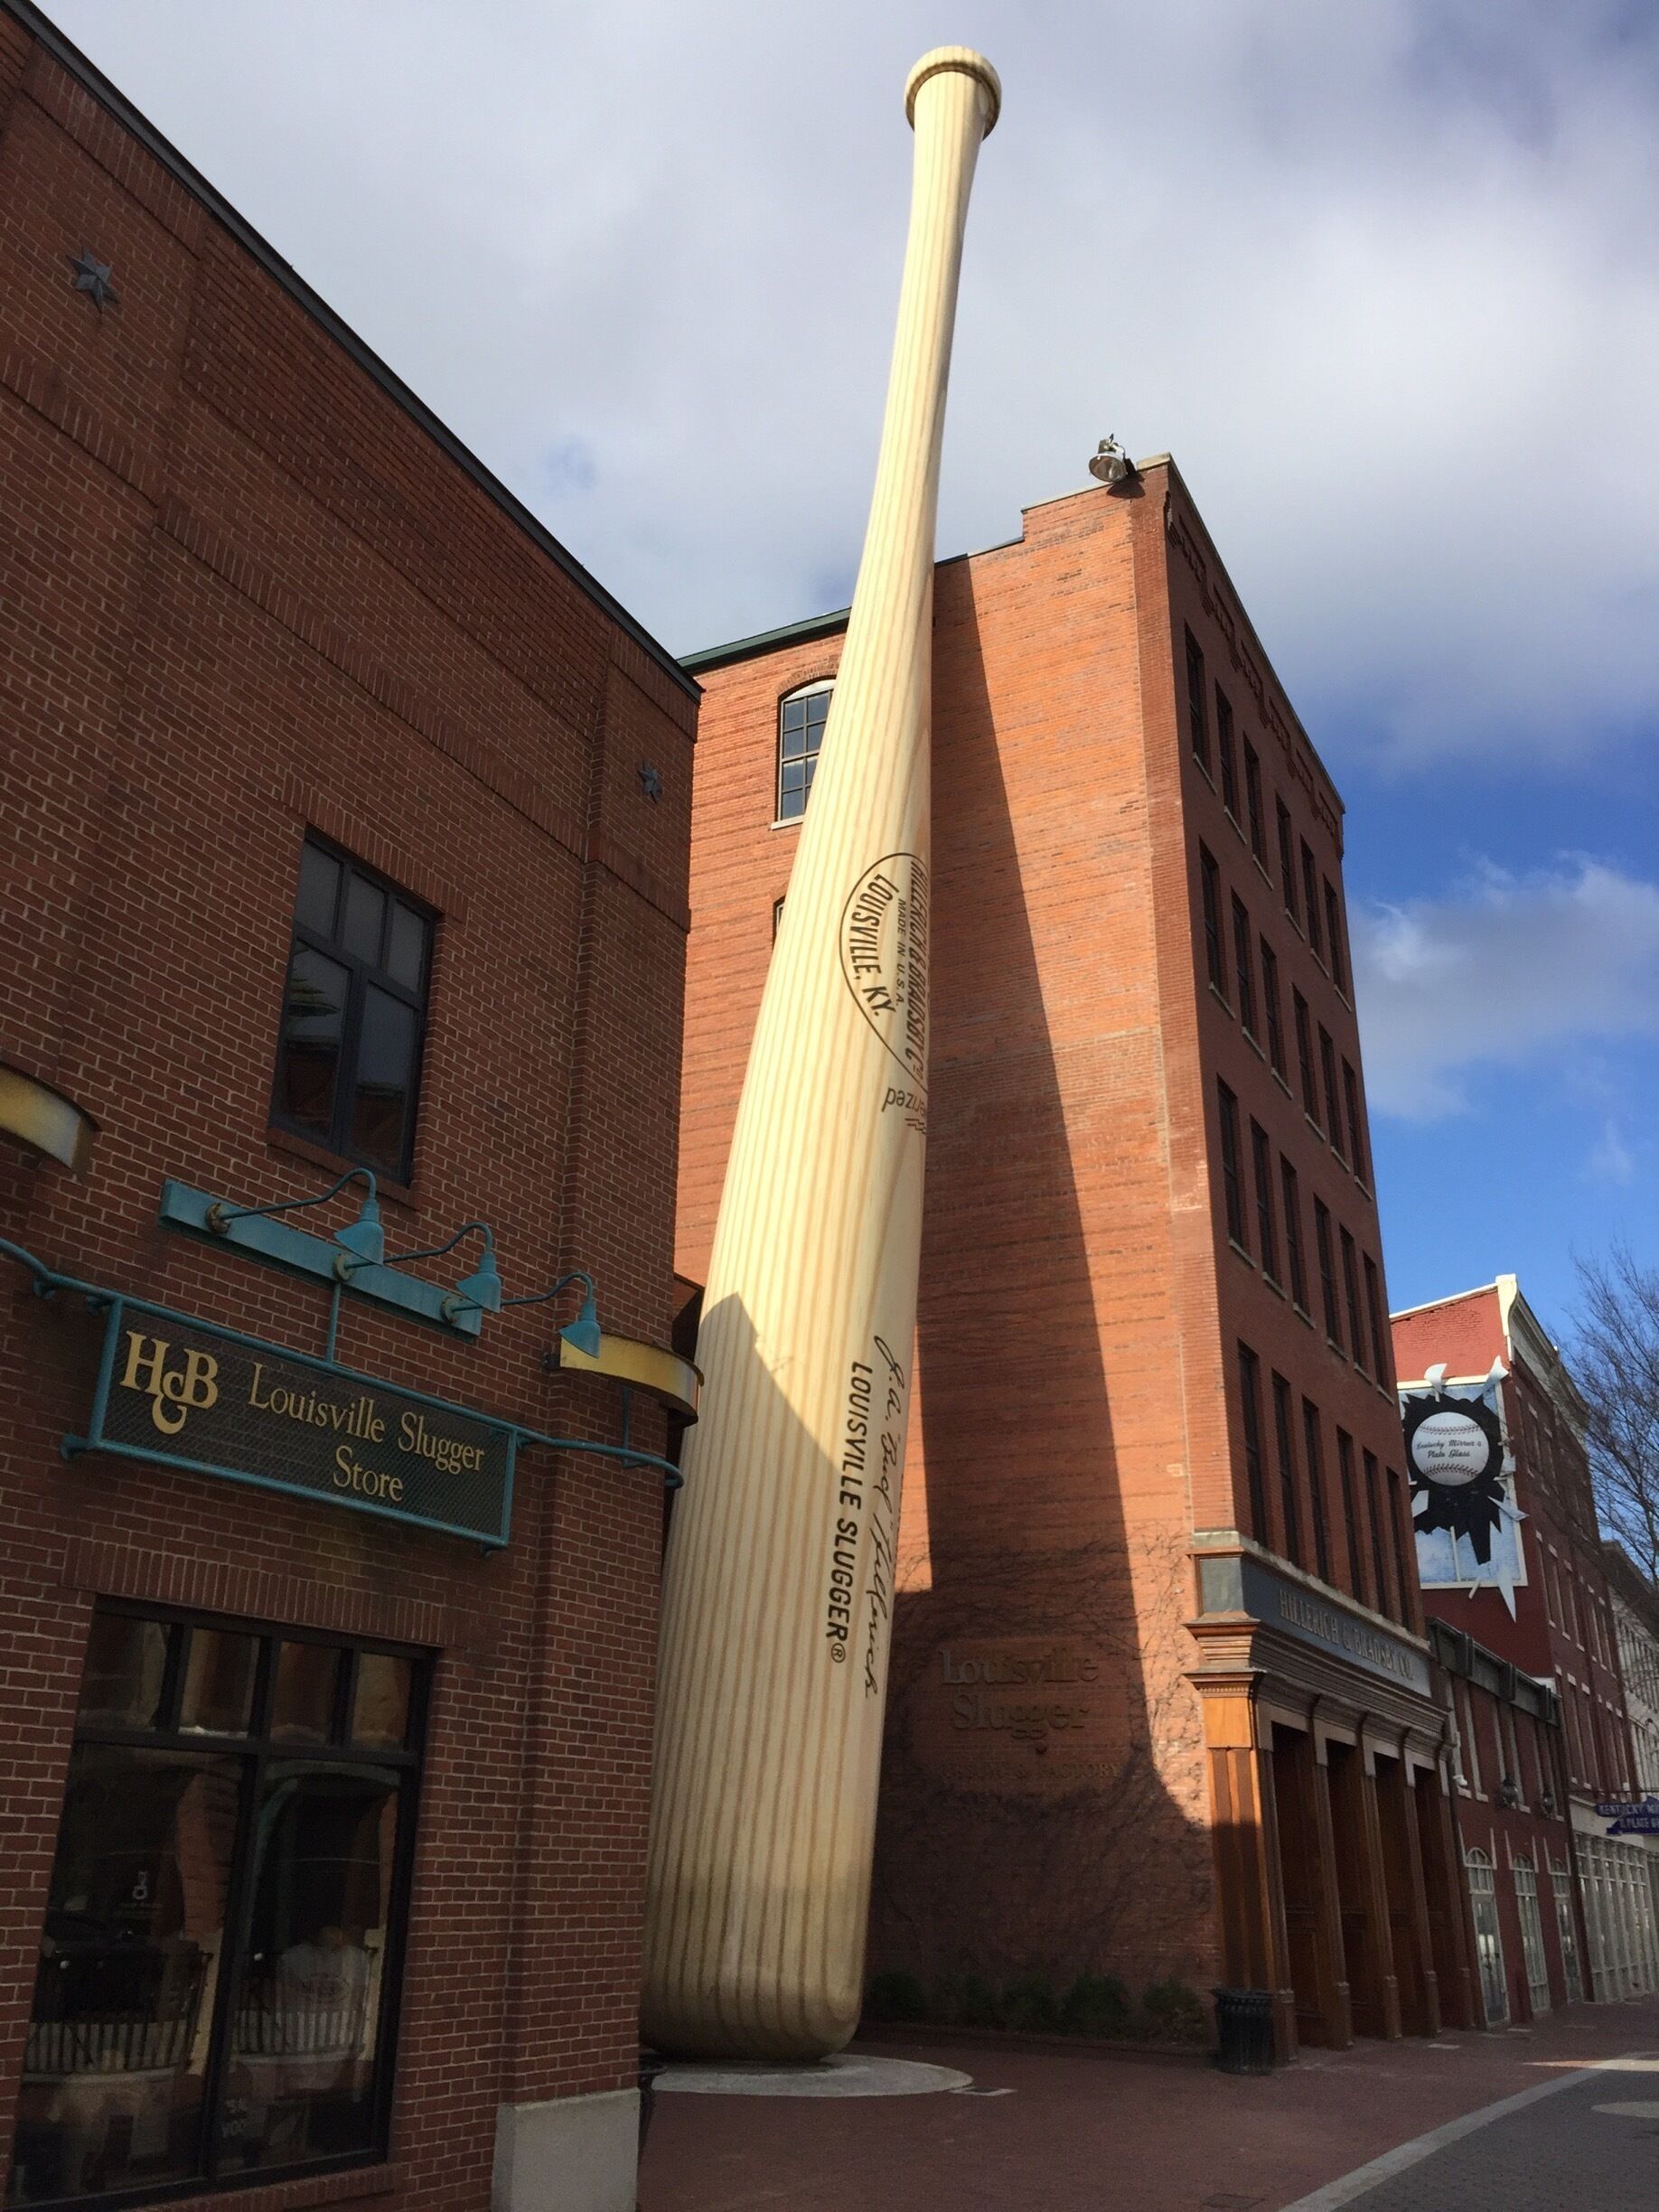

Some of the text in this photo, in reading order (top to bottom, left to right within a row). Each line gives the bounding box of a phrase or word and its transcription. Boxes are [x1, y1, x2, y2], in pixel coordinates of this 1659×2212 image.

[849, 873, 900, 1017] LOUISVILLE, KY.
[909, 860, 928, 957] HILLERICH
[895, 898, 906, 1007] MADE IN U.S.A.
[909, 946, 927, 970] &
[906, 961, 926, 1059] BRADSBY
[118, 1330, 219, 1435] H&B
[246, 1362, 485, 1476] Louisville Slugger
[333, 1446, 404, 1503] Store
[839, 1361, 873, 1511] LOUISVILLE
[1427, 1448, 1470, 1458] Plate Glass
[1448, 1439, 1475, 1448] Mirror
[1279, 1589, 1339, 1645] HILLERICH
[938, 1647, 1099, 1685] Louisville
[952, 1693, 1090, 1740] Slugger
